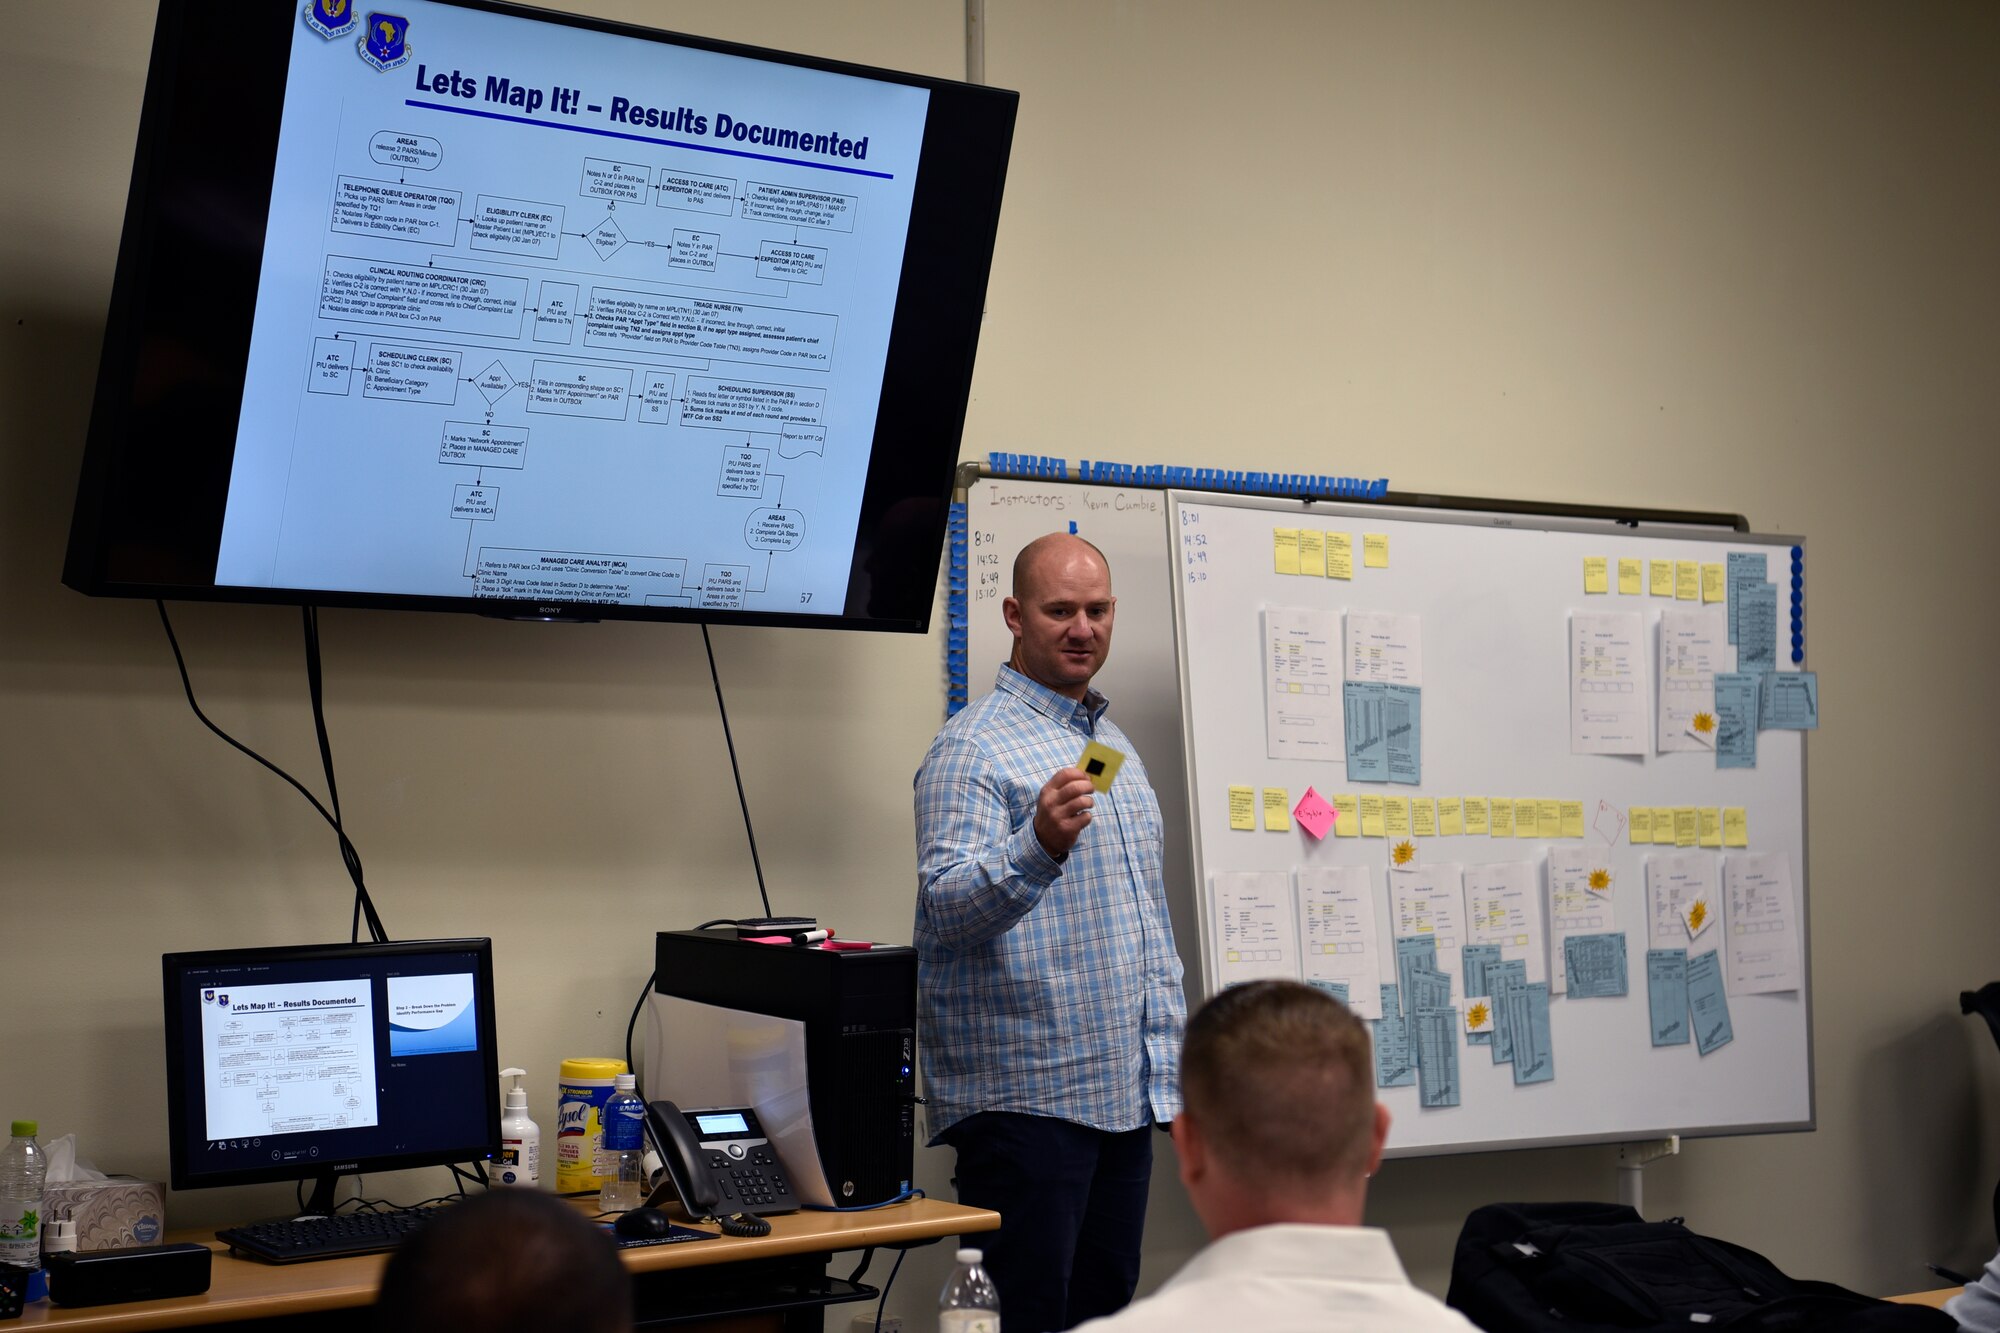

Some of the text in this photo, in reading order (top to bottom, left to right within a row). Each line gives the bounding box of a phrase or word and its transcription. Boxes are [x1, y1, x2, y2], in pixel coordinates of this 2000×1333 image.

[416, 64, 476, 98] Lets
[485, 76, 543, 114] Map
[551, 86, 580, 114] It!
[610, 96, 708, 136] Results
[715, 114, 868, 160] Documented
[396, 137, 417, 146] AREAS
[389, 153, 419, 164] (OUTBOX)
[666, 176, 689, 186] ACCESS
[698, 181, 713, 189] CARE
[713, 183, 728, 192] (ATC)
[343, 183, 380, 194] TELEPHONE
[380, 188, 402, 198] QUEUE
[403, 191, 437, 202] OPERATOR
[589, 185, 613, 195] OUTBOX
[613, 189, 625, 197] FOR
[758, 186, 845, 205] PATIENT ADMIN SUPERVISOR (PAS)
[486, 207, 552, 222] ELIGIBILITY CLERK (EC)
[770, 249, 792, 257] ACCESS
[369, 266, 486, 287] CLINCAL ROUTING COORDINATOR (CRC)
[693, 301, 713, 309] TRIAGE
[378, 351, 452, 365] SCHEDULING CLERK (SC)
[717, 384, 751, 394] SCHEDULING
[751, 388, 784, 397] SUPERVISOR
[441, 450, 466, 458] OUTBOX
[990, 486, 1072, 510] Instructors:
[1083, 492, 1109, 510] Kevin
[1182, 510, 1199, 526] 8:01
[975, 531, 995, 546] 8:01
[1184, 534, 1207, 546] 14:52
[977, 554, 999, 566] 14:52
[1188, 551, 1207, 564] 6:49
[981, 572, 999, 584] 6:49
[1188, 572, 1207, 583] 15:10
[976, 587, 996, 600] 15:10
[313, 997, 356, 1006] Documented
[903, 1038, 911, 1061] Z230
